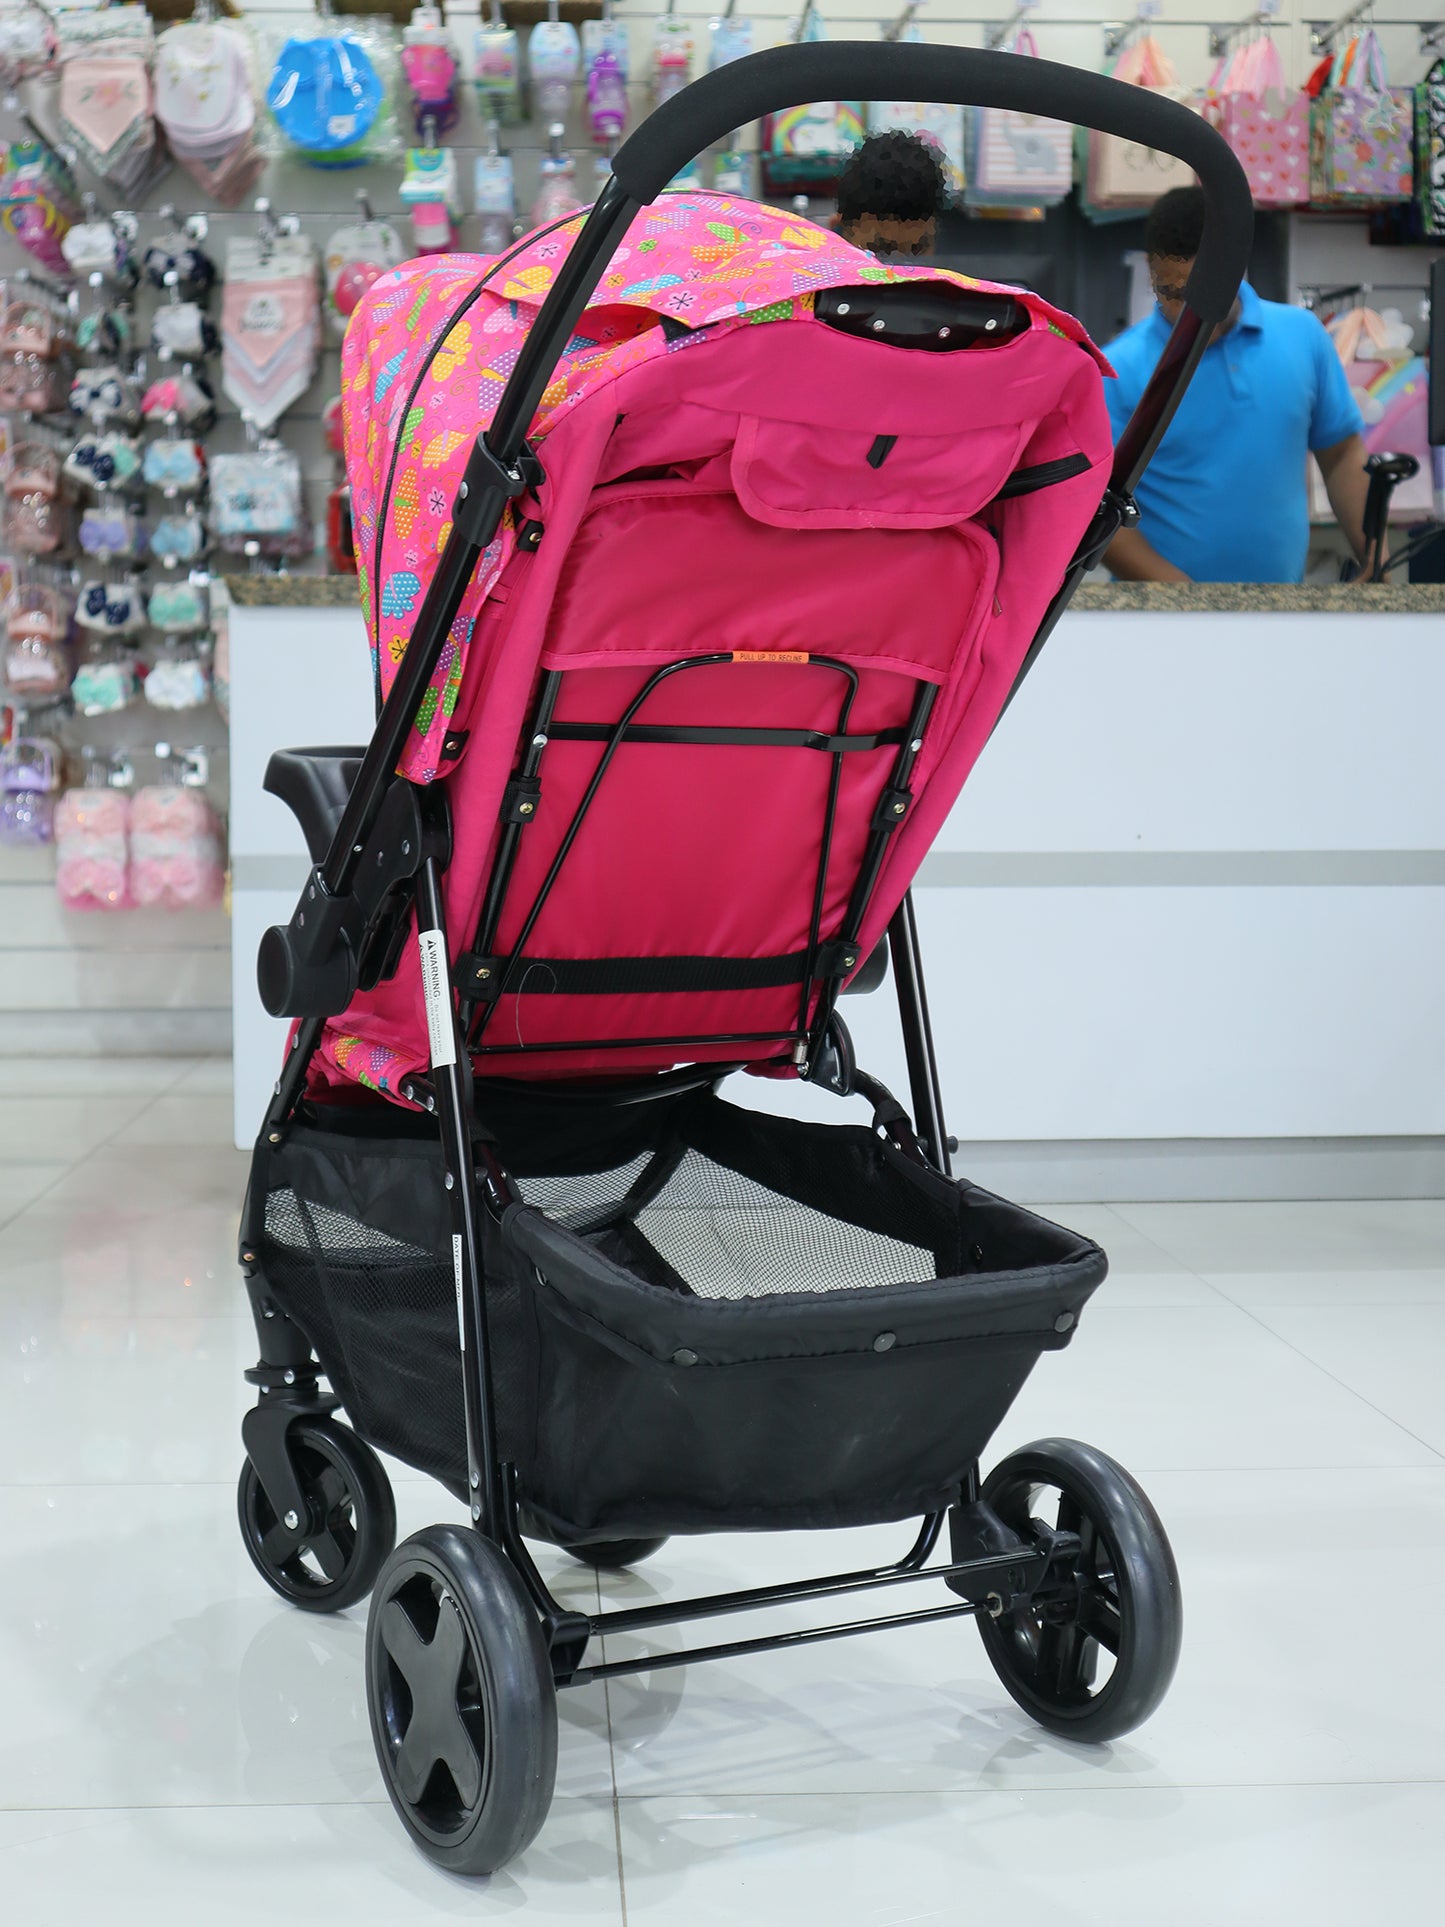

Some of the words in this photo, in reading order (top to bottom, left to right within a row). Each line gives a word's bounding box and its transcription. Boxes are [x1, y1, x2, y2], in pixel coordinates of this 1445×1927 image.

[740, 652, 754, 661] PULL
[758, 653, 766, 661] UP
[769, 653, 776, 661] TO
[779, 654, 802, 662] RECLINE
[456, 1263, 460, 1276] OF
